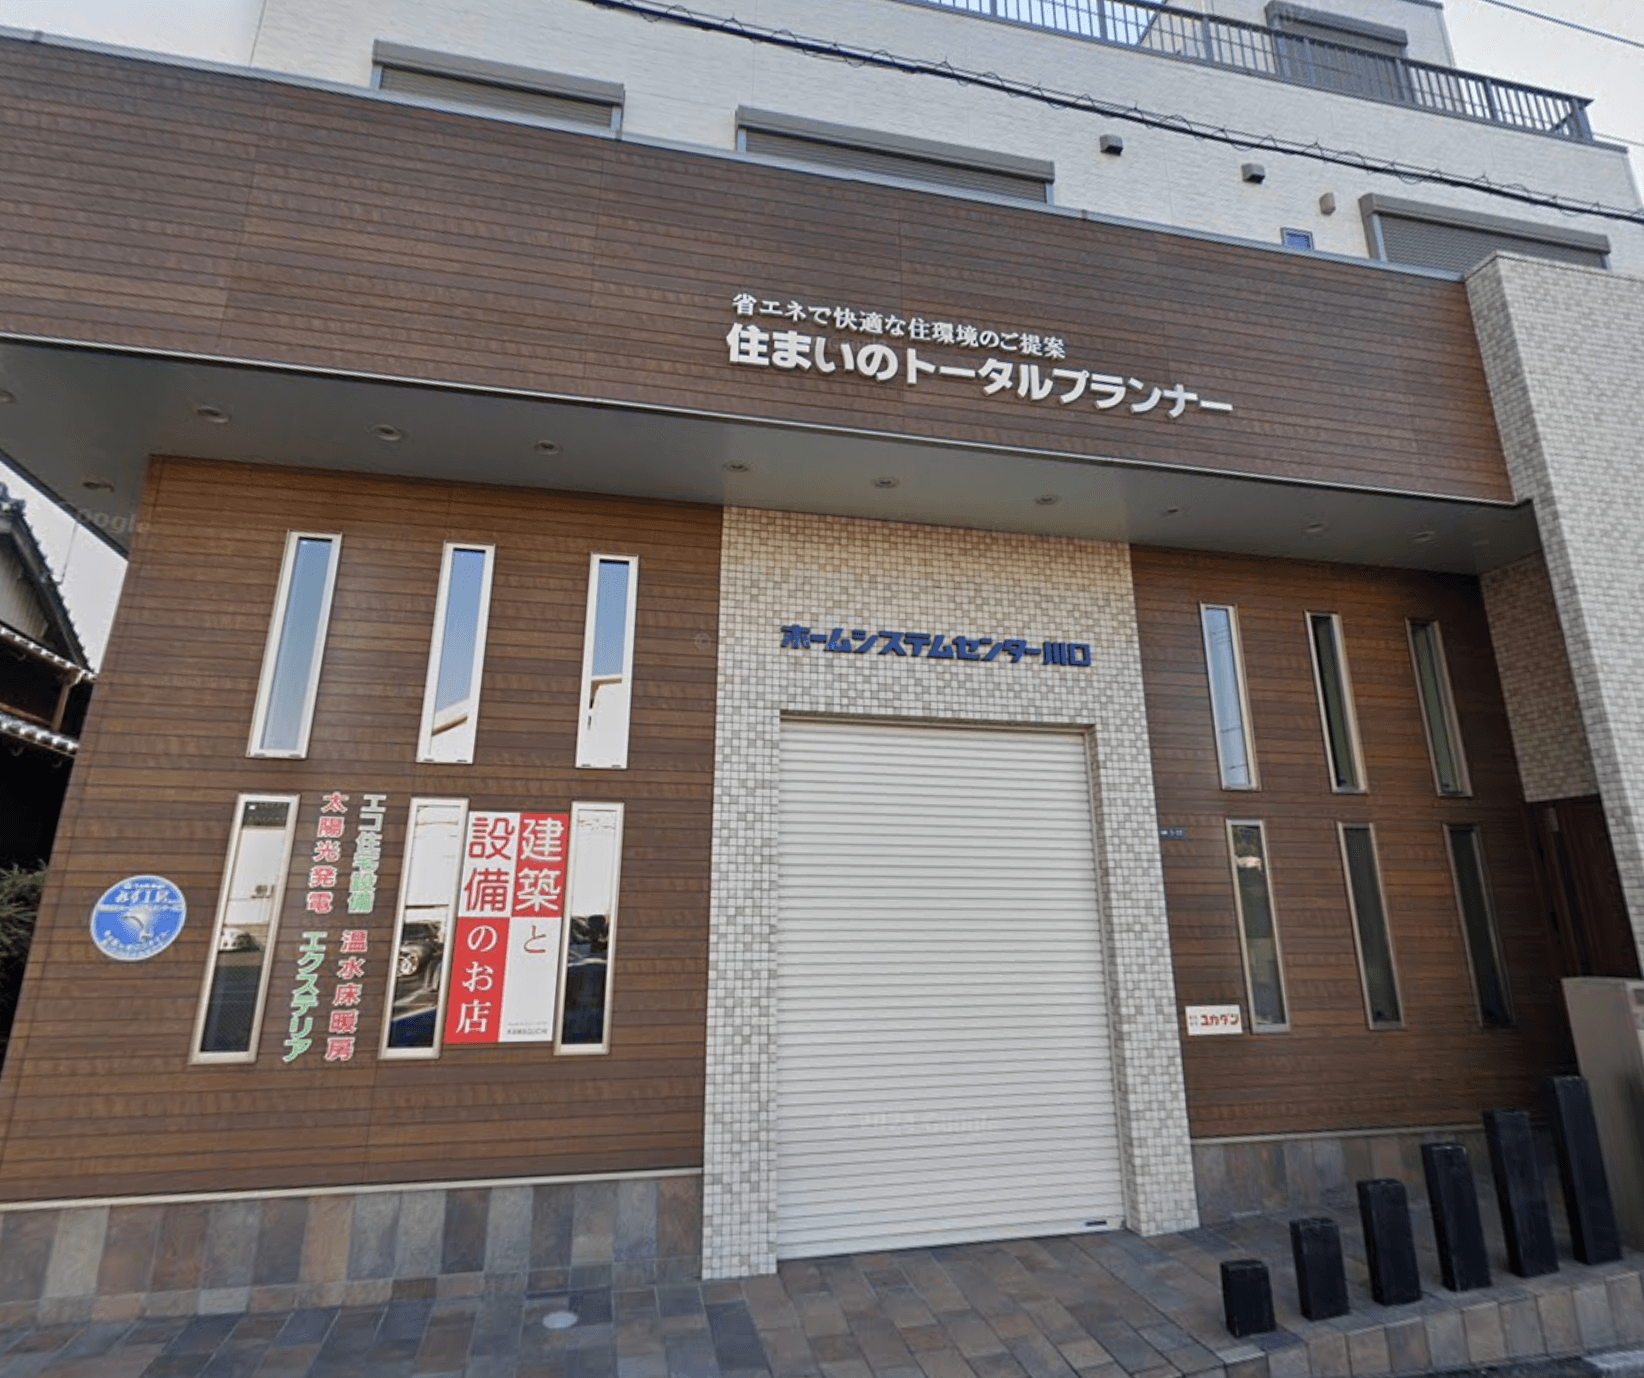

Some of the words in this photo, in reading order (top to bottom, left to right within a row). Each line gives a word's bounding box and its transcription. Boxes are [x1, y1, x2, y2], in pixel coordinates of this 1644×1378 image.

[726, 322, 1234, 420] 住まいのトータルプランナー
[731, 293, 1067, 360] 省エネで快適な住環境のご提案
[780, 624, 1092, 667] ホームシステムセンター川口
[306, 791, 350, 914] 太陽光発電
[347, 793, 388, 915] エコ住宅設備
[514, 816, 565, 954] 建築と
[455, 816, 516, 1034] 設備のお店
[282, 931, 329, 1064] エクステリア
[324, 929, 369, 1062] 温水床暖房
